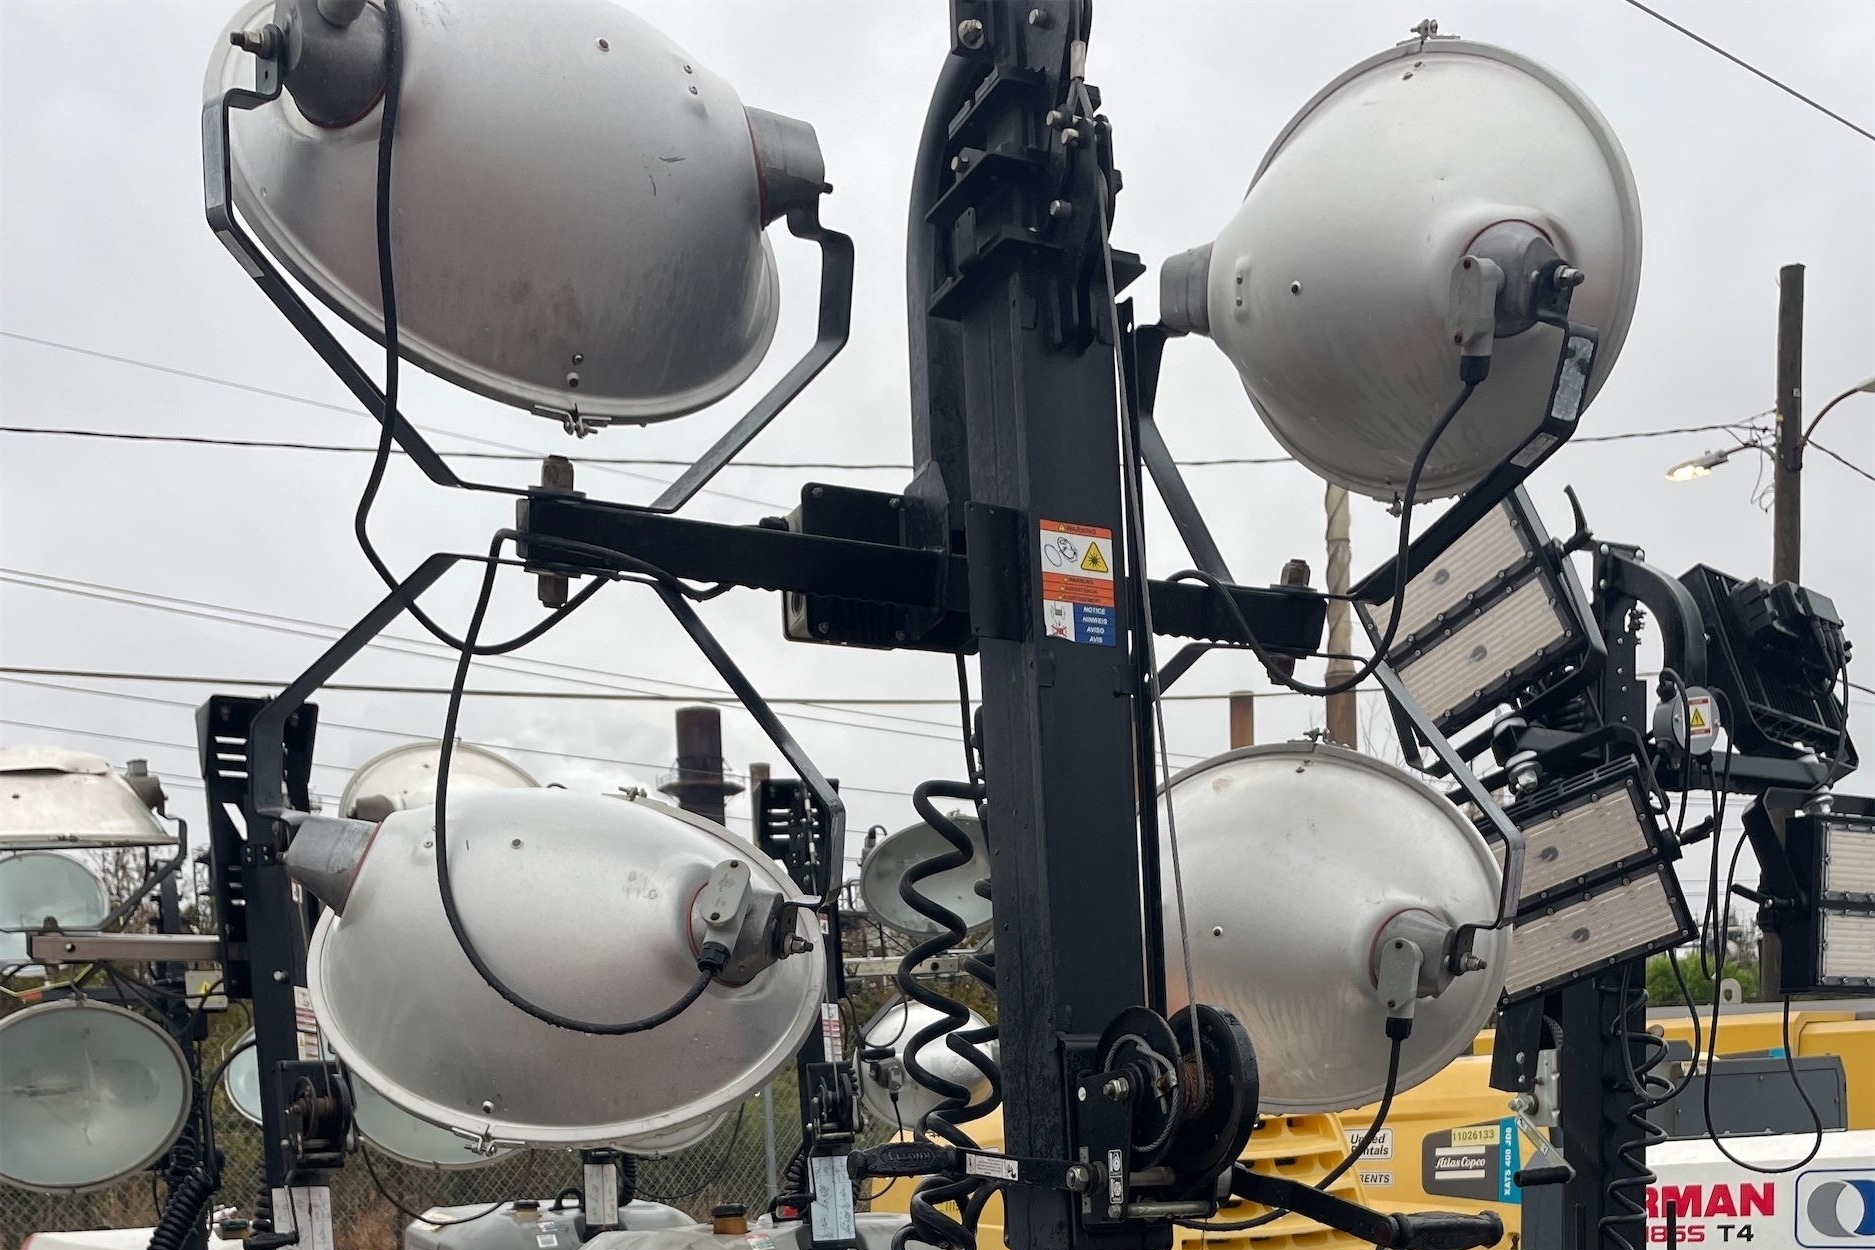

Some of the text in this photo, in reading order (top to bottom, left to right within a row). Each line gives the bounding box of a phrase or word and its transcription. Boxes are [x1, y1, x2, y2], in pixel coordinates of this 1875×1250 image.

[1083, 606, 1106, 615] NOTICE
[1086, 626, 1105, 634] AVISO
[1351, 1133, 1386, 1144] Ued
[1453, 1129, 1494, 1141] 11026133
[1352, 1145, 1389, 1155] ntals
[1435, 1156, 1486, 1169] Atlas Copco
[1504, 1148, 1512, 1167] 400
[1717, 1224, 1754, 1242] T4
